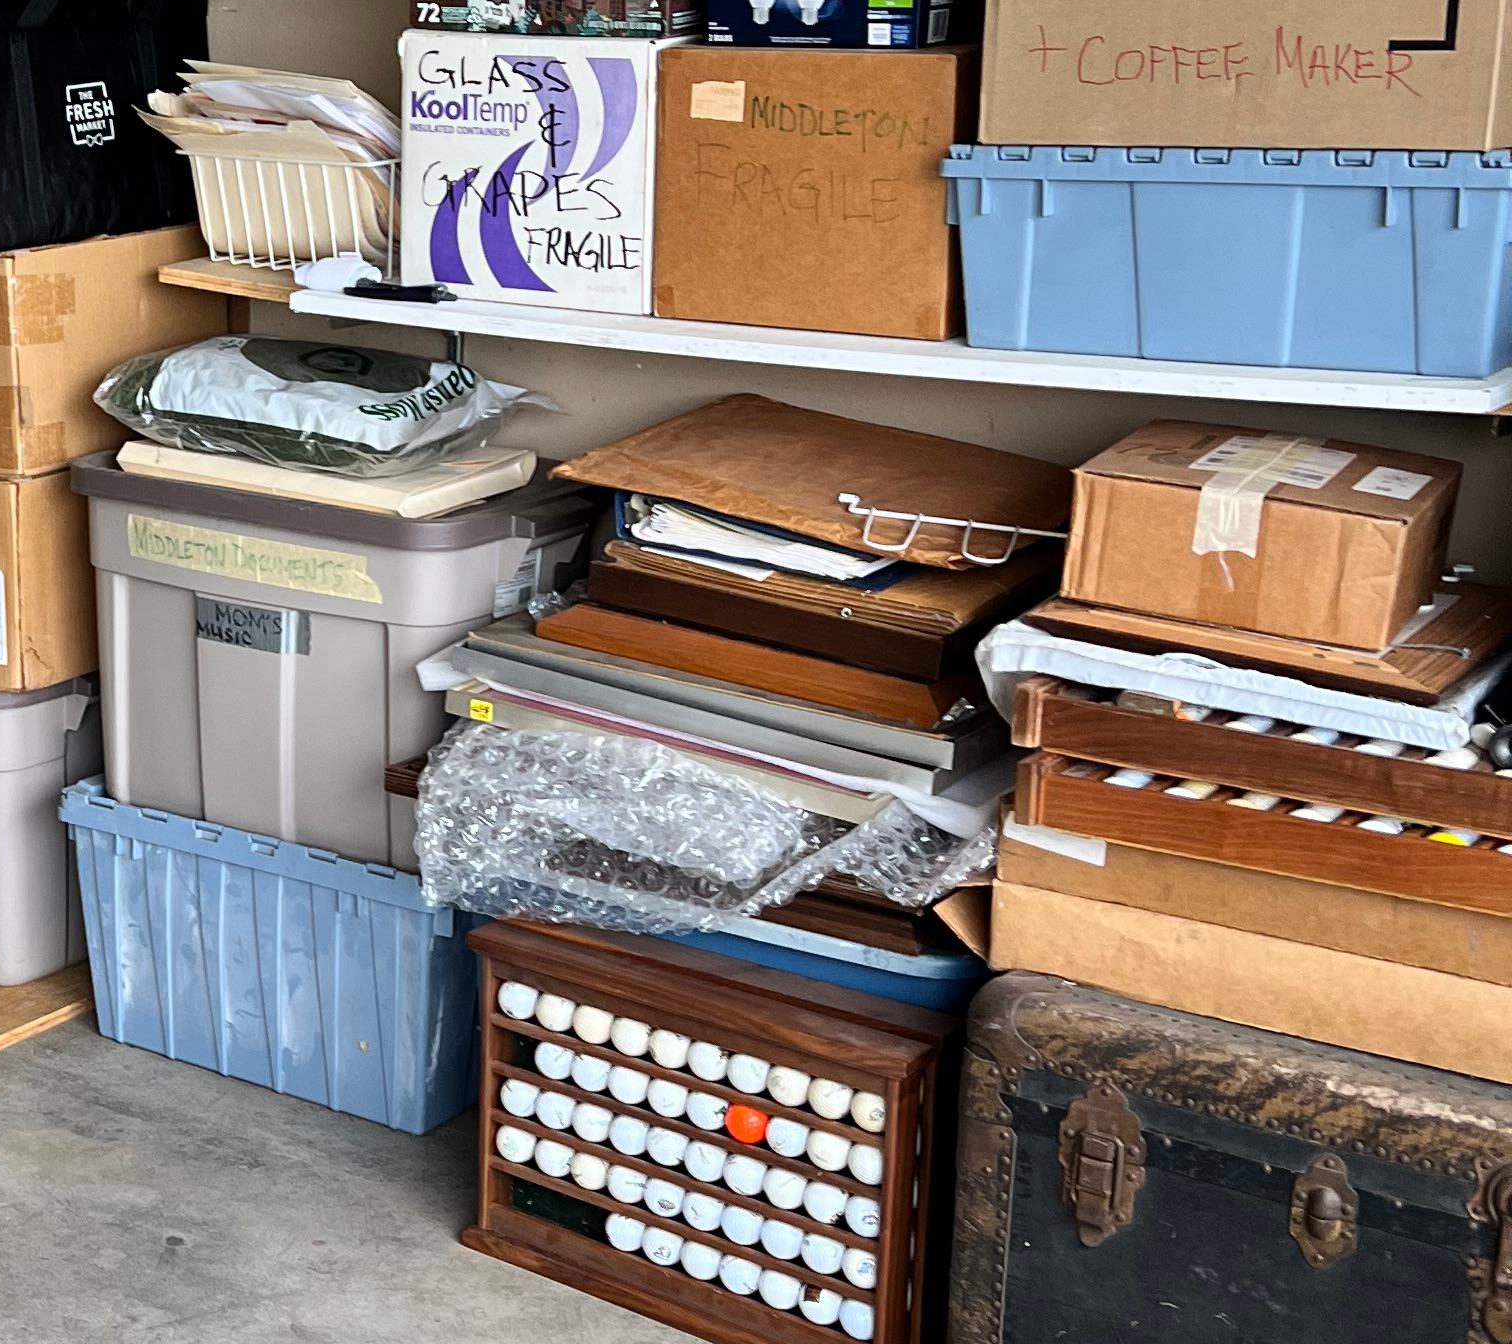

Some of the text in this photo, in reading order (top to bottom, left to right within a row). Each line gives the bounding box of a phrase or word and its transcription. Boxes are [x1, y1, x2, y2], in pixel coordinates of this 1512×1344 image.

[417, 3, 440, 23] 72
[417, 49, 570, 95] GLASS
[1027, 24, 1423, 98] + COFFEE MAKER
[65, 99, 115, 123] FRESH
[78, 90, 94, 101] THE
[410, 89, 530, 132] KoolTemp
[75, 119, 107, 133] MARKET
[409, 123, 511, 138] INSULATED CONTAINERS
[750, 94, 930, 154] MIDDLETON
[421, 160, 622, 221] GRAPES
[694, 139, 902, 226] FRAGILE
[522, 226, 642, 274] FRAGILE
[132, 522, 346, 586] MIDDLETON DOCUMENTS
[196, 619, 253, 646] MUSIC
[214, 603, 284, 636] MOM'S
